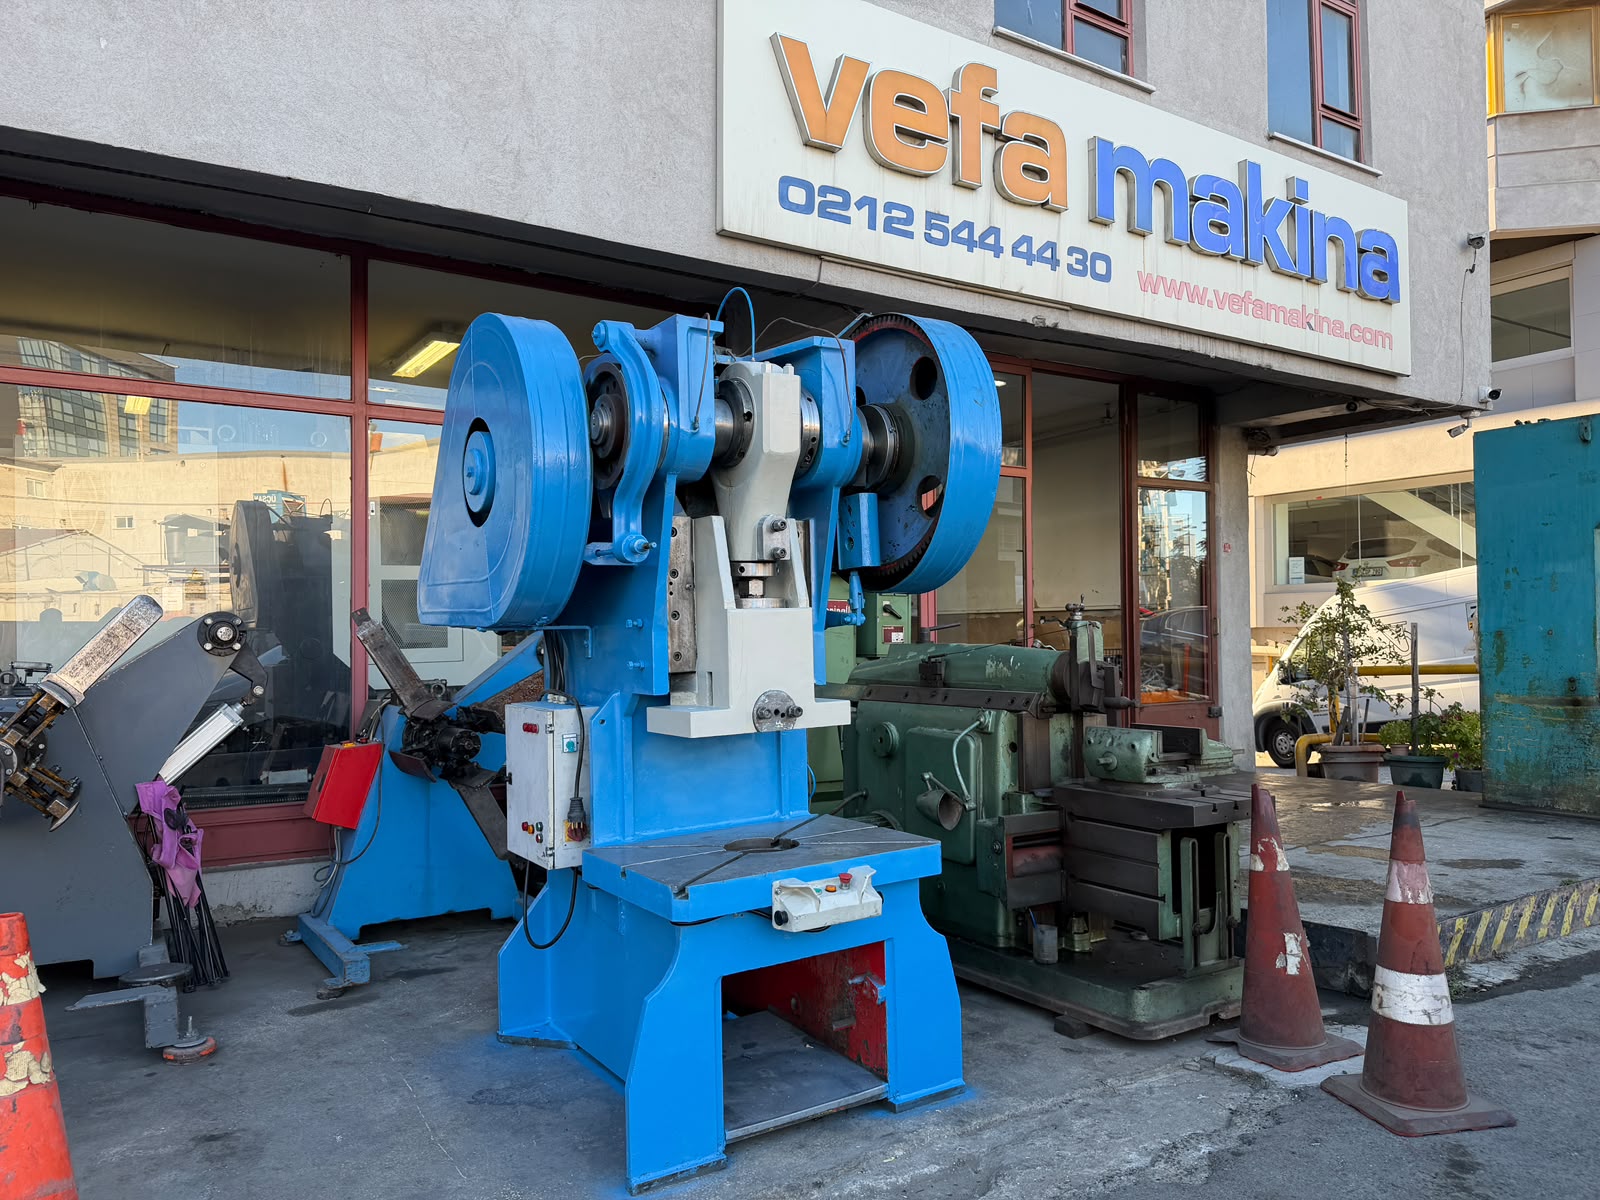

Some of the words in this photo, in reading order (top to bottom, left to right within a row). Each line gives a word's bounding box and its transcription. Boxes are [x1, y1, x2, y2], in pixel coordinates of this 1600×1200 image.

[770, 32, 1068, 213] vefa
[1088, 136, 1401, 304] makina
[778, 175, 914, 239] 0212
[924, 210, 1003, 258] 544
[1011, 234, 1060, 271] 44
[1066, 245, 1112, 283] 30
[1137, 270, 1393, 350] www.vefamakina.com
